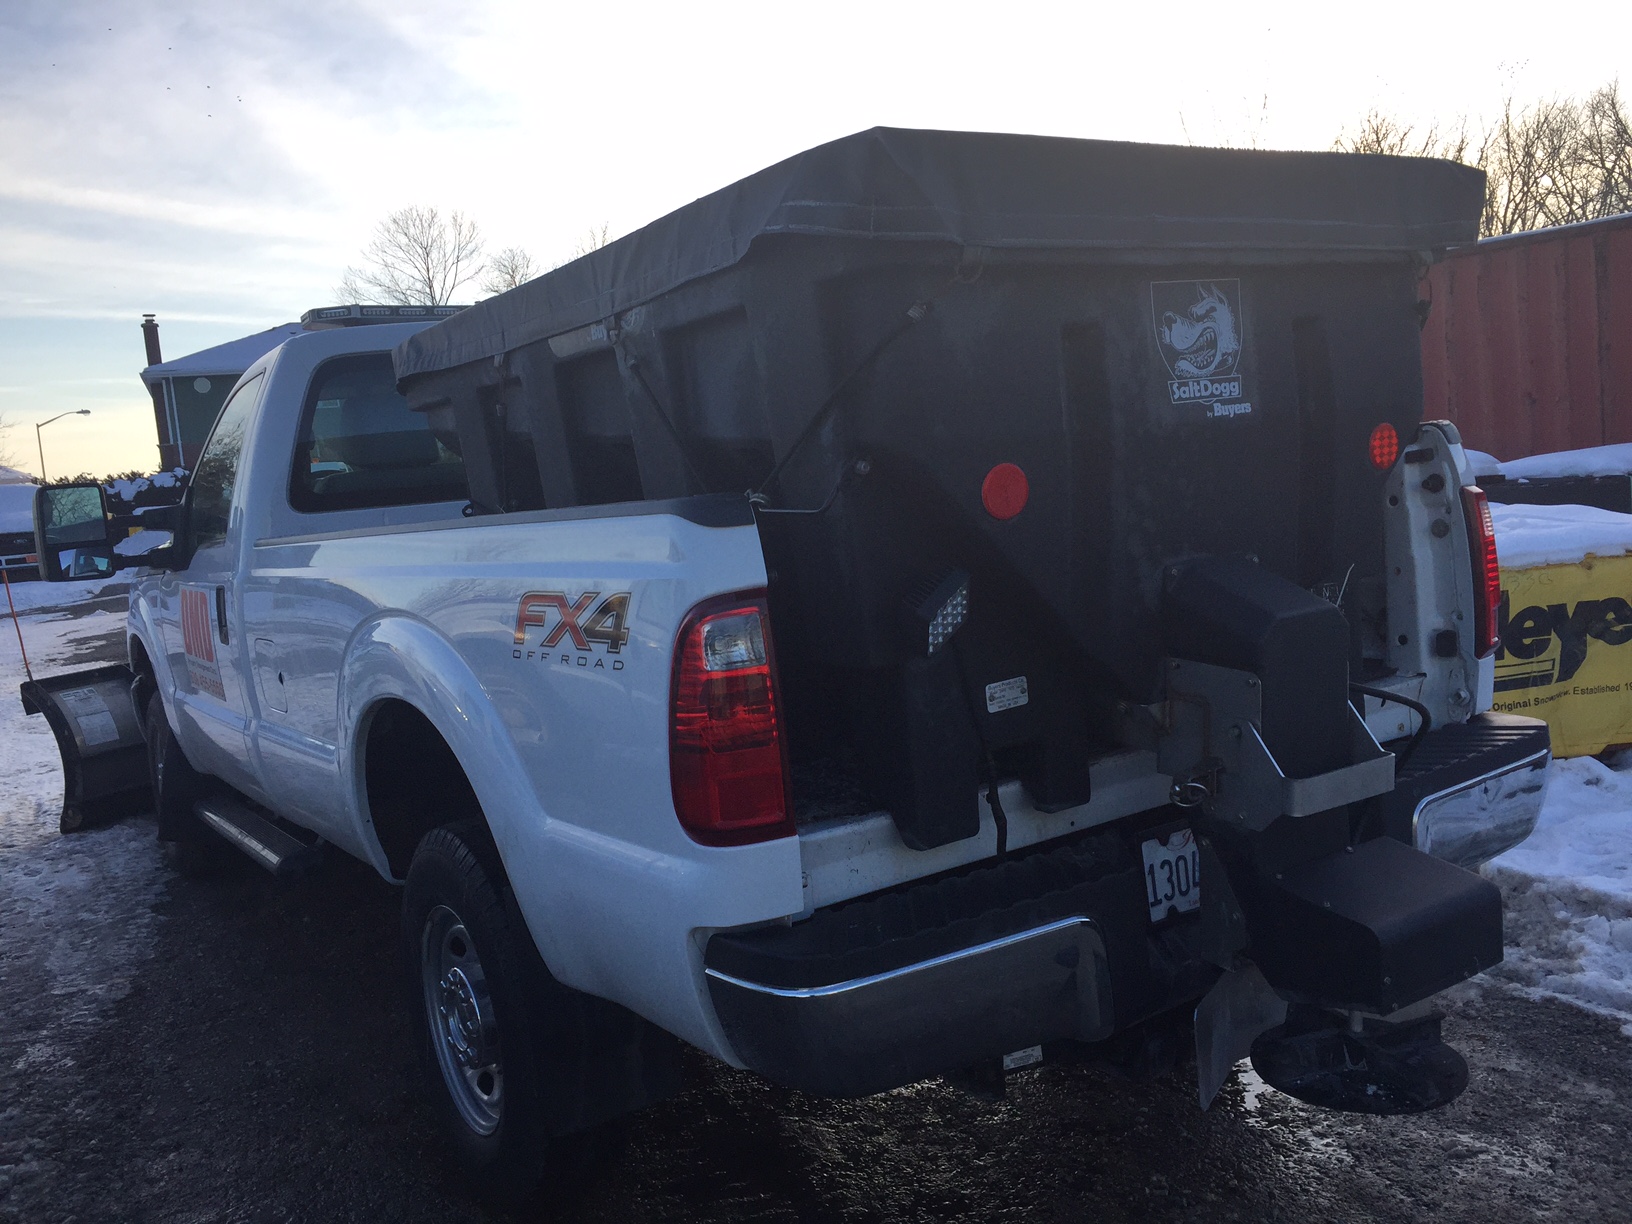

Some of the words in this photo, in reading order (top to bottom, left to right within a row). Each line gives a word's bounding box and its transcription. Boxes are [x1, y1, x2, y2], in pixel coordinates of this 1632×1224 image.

[1172, 380, 1239, 399] SaltDogg
[1213, 402, 1252, 418] Buyers
[513, 590, 632, 654] FX4
[512, 649, 550, 662] OFF
[560, 654, 625, 671] ROAD
[1492, 699, 1531, 712] Original
[1573, 683, 1620, 695] Established
